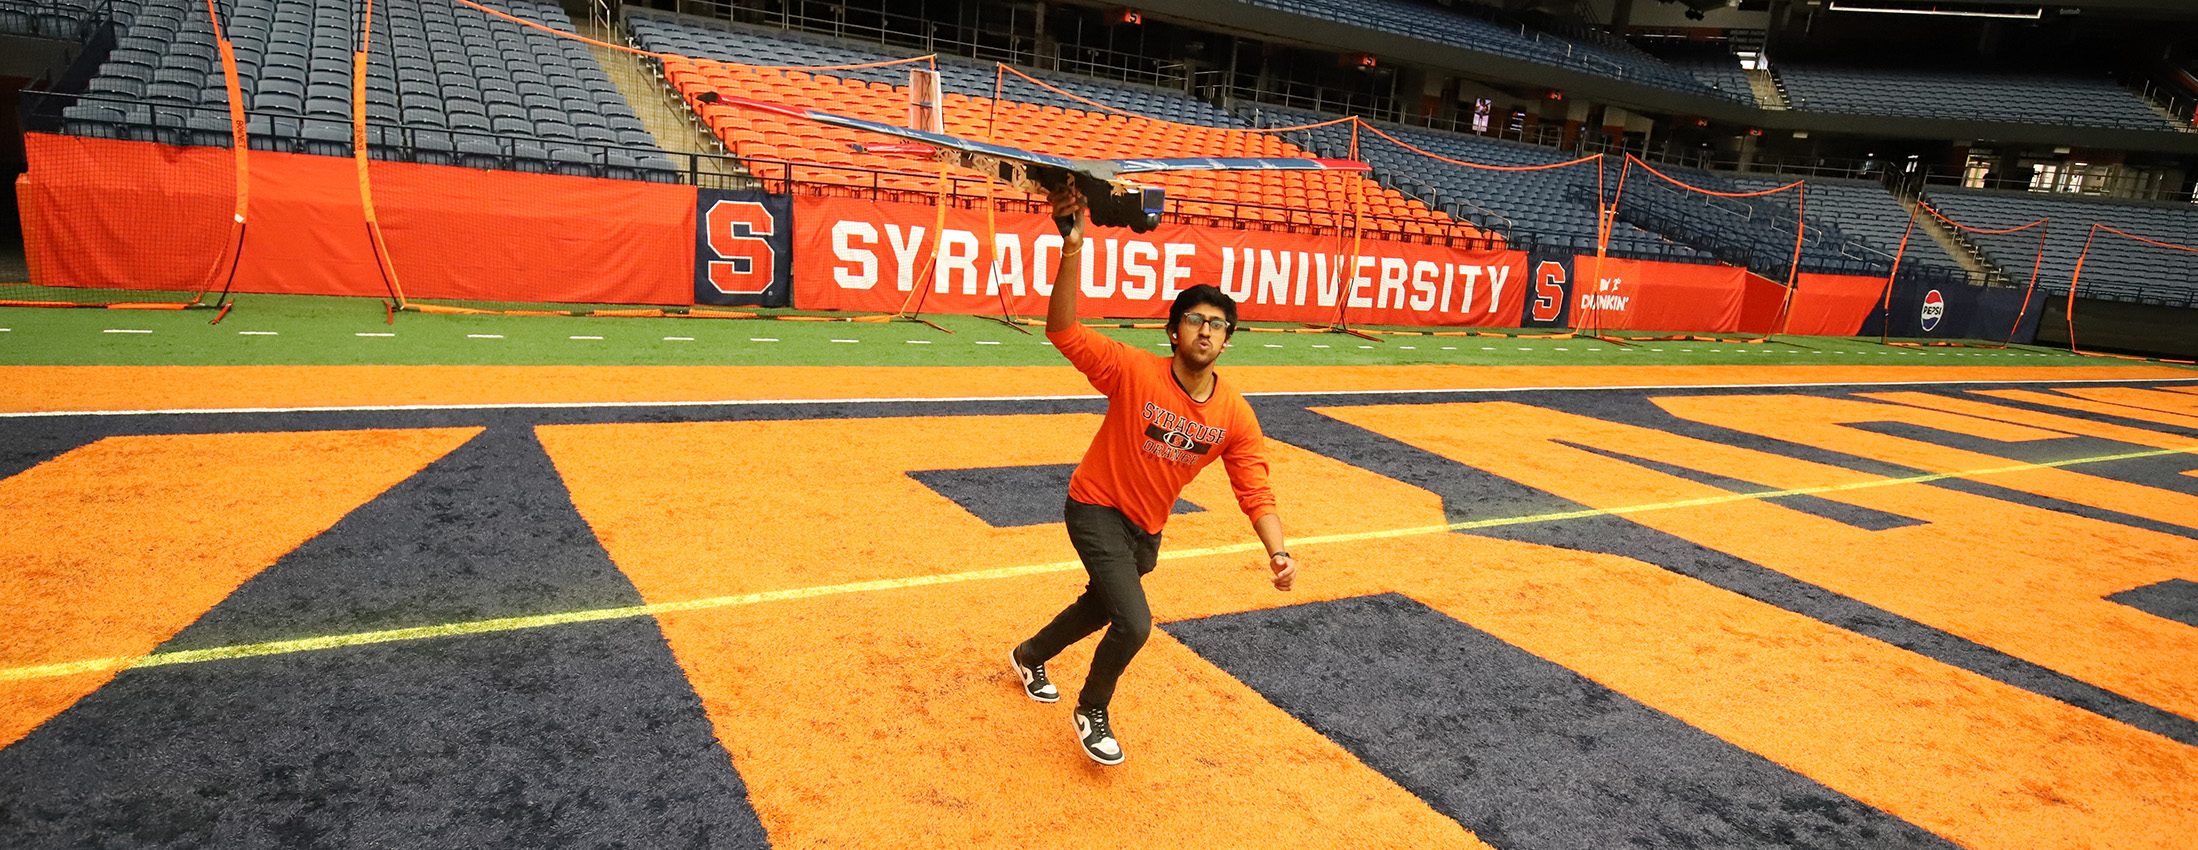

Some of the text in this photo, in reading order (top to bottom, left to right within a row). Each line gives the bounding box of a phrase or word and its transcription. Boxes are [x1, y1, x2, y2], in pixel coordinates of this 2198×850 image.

[706, 200, 774, 294] S
[831, 220, 1510, 313] SYRACUSE UNIVERSITY
[1532, 261, 1566, 321] S
[1923, 306, 1942, 315] PEPSI
[1142, 401, 1227, 444] SYRACUSE
[1143, 439, 1200, 465] ORANGE
